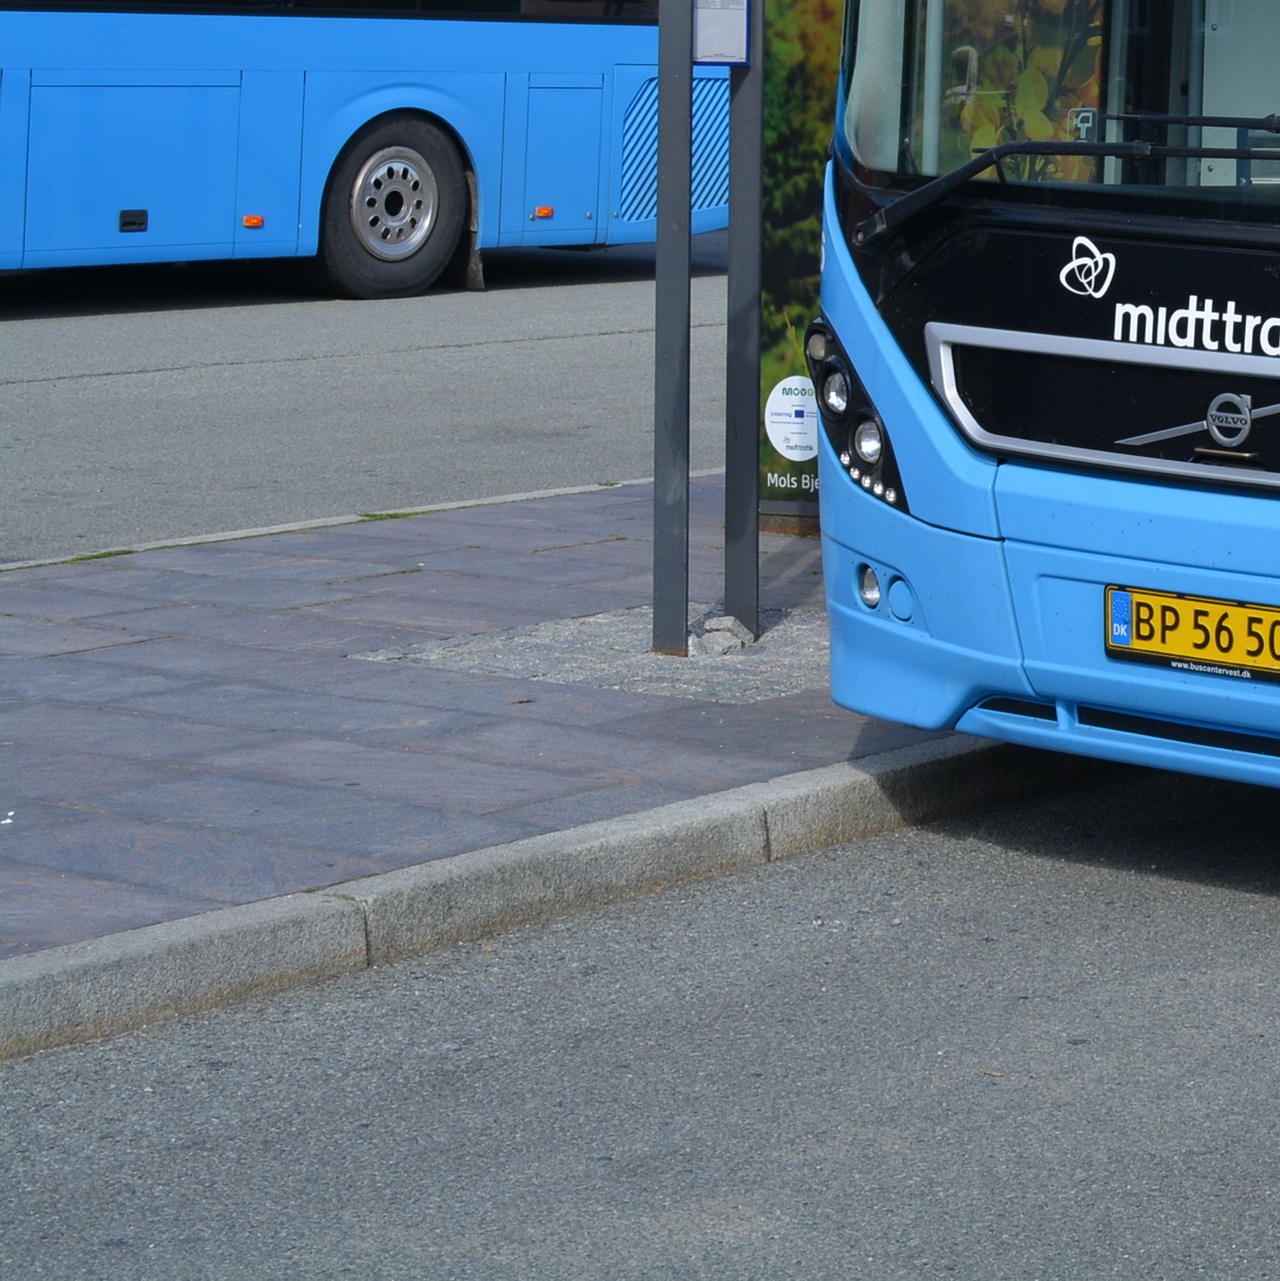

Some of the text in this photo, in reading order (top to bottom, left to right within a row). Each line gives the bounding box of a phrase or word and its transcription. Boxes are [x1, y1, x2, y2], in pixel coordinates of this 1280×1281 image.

[1209, 414, 1248, 426] VOLVO
[767, 472, 798, 488] Mols
[1112, 623, 1128, 637] DK
[1135, 601, 1180, 644] BP
[1192, 609, 1234, 654] 56
[1170, 660, 1252, 679] www.buscentervest.dk
